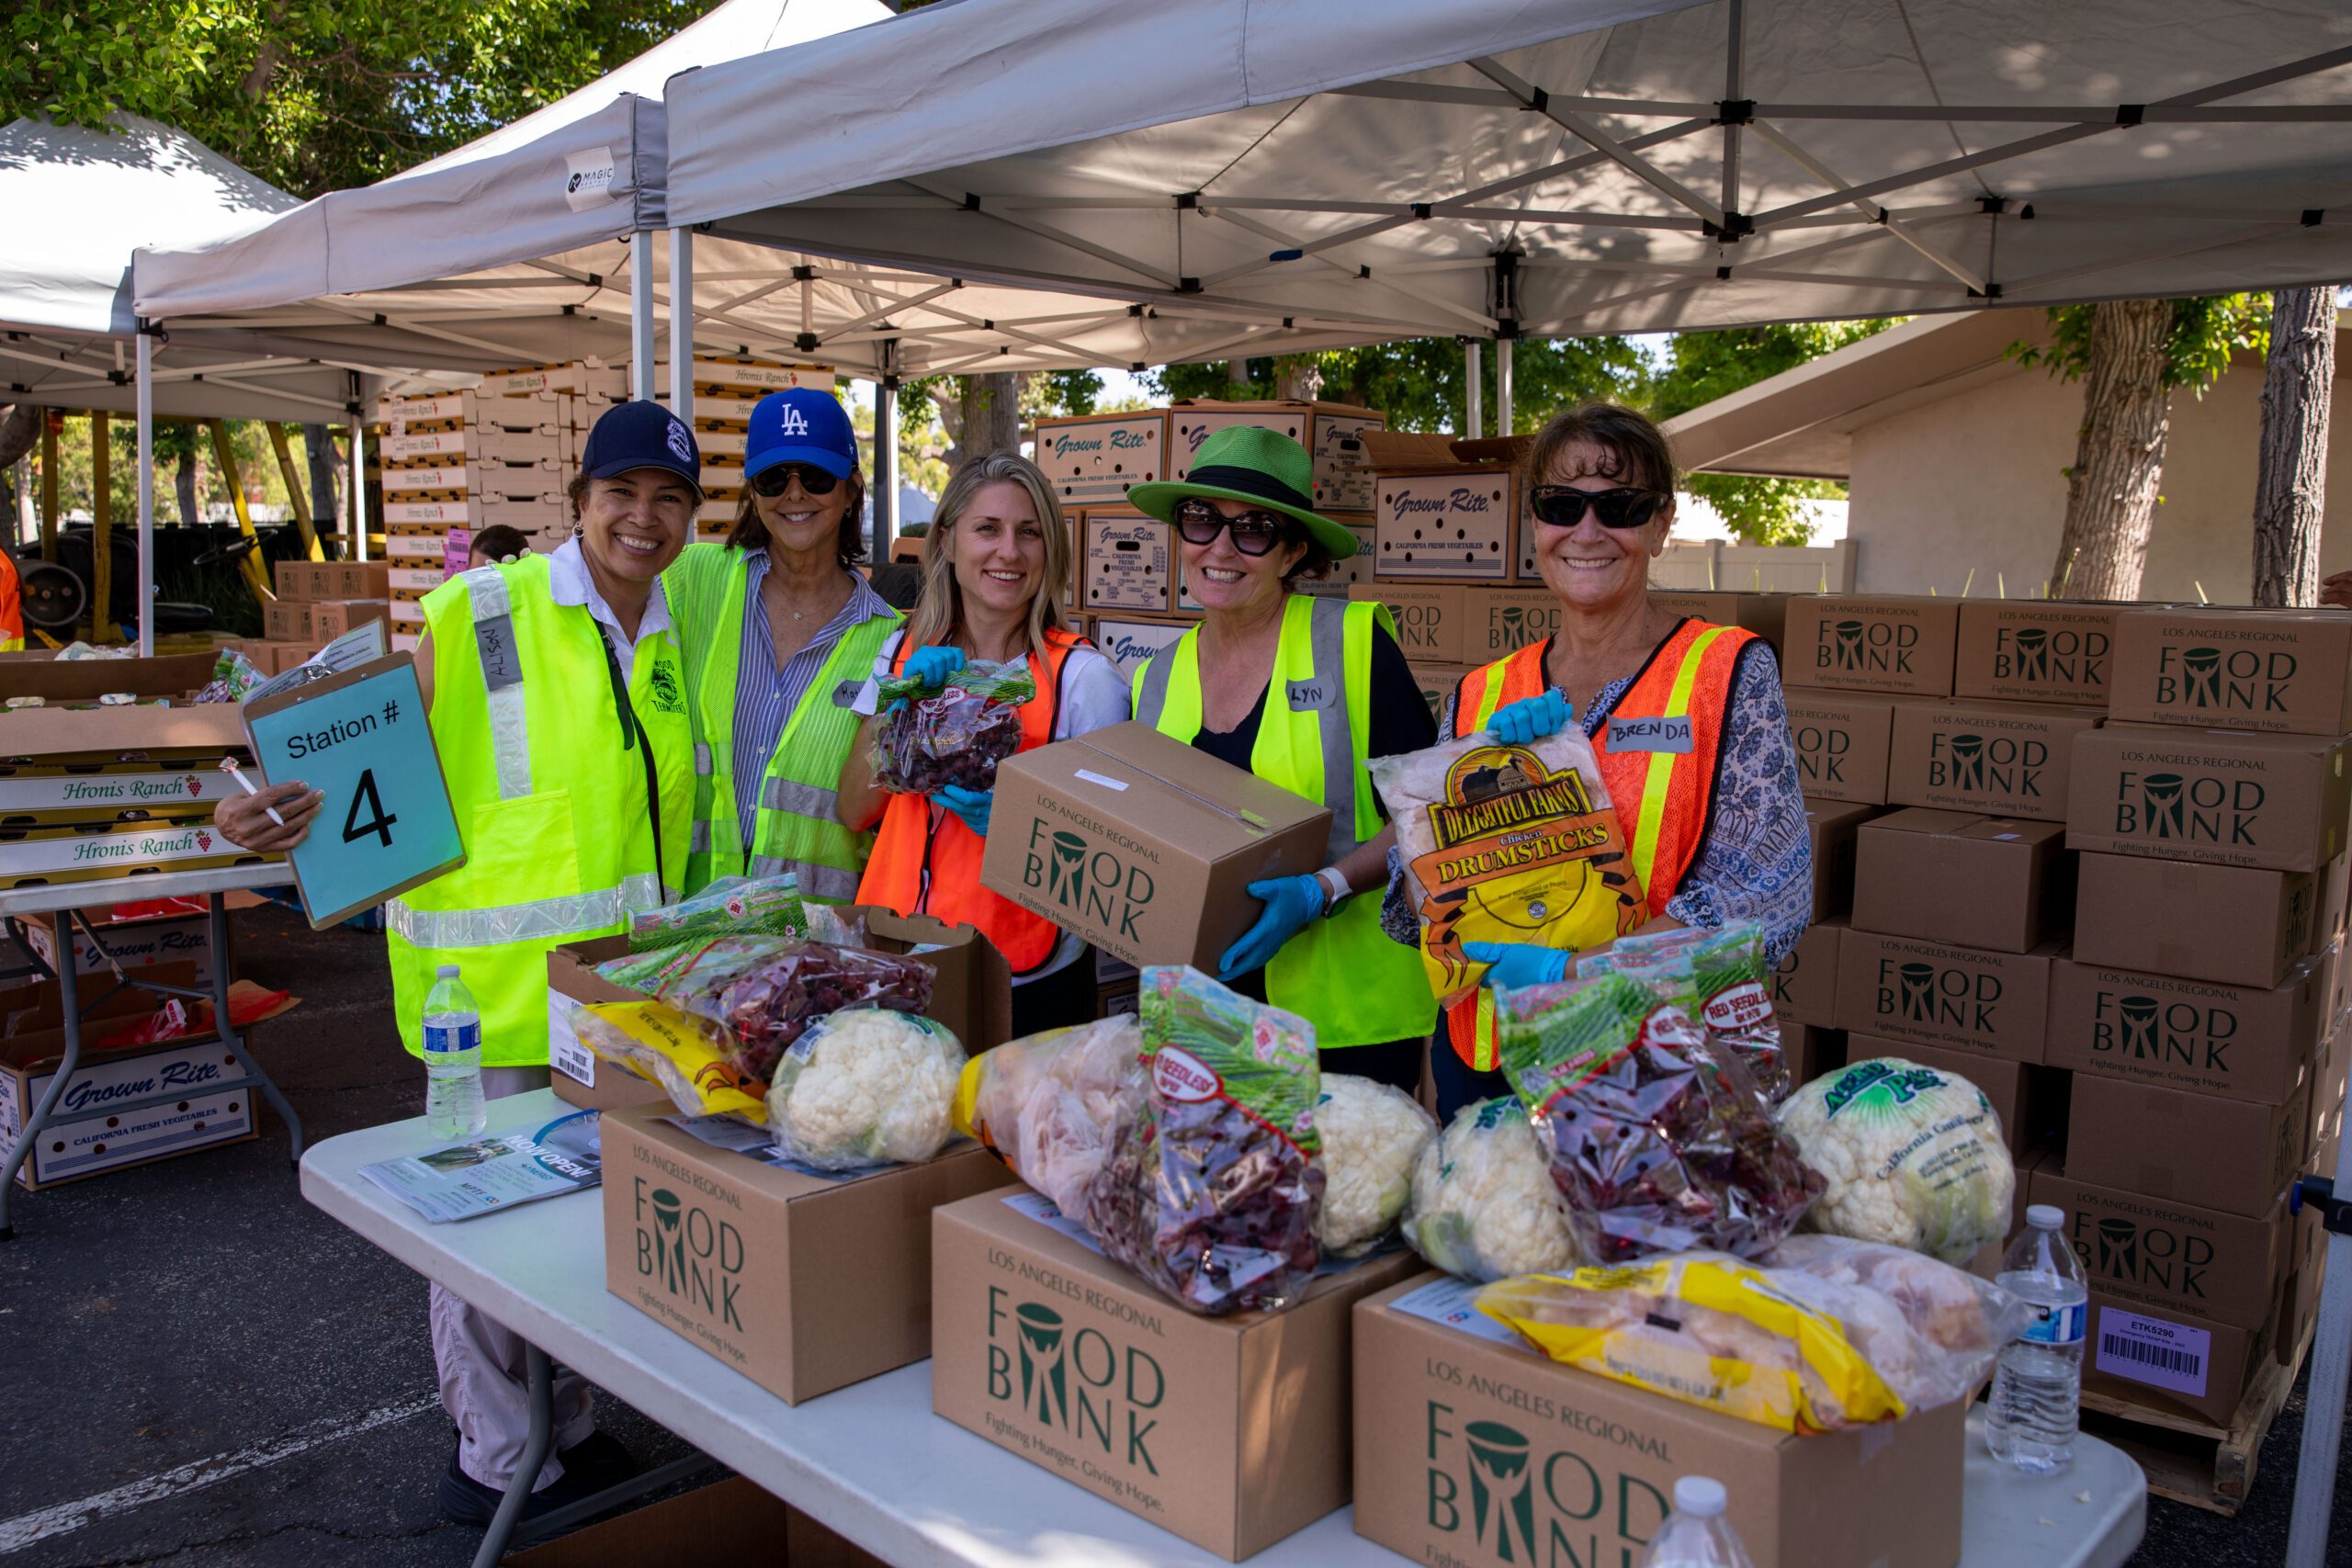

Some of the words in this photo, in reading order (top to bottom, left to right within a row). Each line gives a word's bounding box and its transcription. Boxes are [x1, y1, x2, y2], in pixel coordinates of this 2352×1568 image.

[735, 369, 763, 382] Hronis
[763, 371, 790, 384] Ranch
[781, 403, 808, 437] LA
[1055, 434, 1103, 460] Grown
[1393, 489, 1447, 522] Grown
[1100, 526, 1131, 545] Grown
[1446, 541, 1484, 549] VEGETABLES
[1820, 604, 1836, 613] LOS
[1838, 605, 1874, 615] ANGELES
[1876, 606, 1920, 616] REGIONAL
[1998, 611, 2017, 620] LOS
[2019, 612, 2060, 622] ANGELES
[2062, 614, 2110, 625] REGIONAL
[2163, 628, 2186, 637] LOS
[2188, 629, 2236, 640] ANGELES
[2237, 631, 2300, 644] REGIONAL
[1420, 676, 1450, 685] ANGELES
[1815, 673, 1840, 684] Fighting
[1841, 676, 1868, 685] Hunger.
[1870, 677, 1893, 687] Giving
[1894, 679, 1915, 688] Hope.
[1291, 686, 1323, 703] LYN
[286, 713, 378, 760] Station
[382, 699, 401, 726] #
[1806, 711, 1851, 722] REGIONAL
[1933, 716, 1951, 725] LOS
[1954, 717, 1996, 728] ANGELES
[1998, 720, 2050, 733] REGIONAL
[2153, 711, 2188, 724] Fighting
[2190, 713, 2224, 727] Hunger.
[2228, 716, 2259, 729] Giving
[2261, 719, 2291, 730] Hope.
[1611, 720, 1690, 742] BRENDA
[2120, 750, 2144, 761] LOS
[2146, 752, 2200, 765] ANGELES
[2203, 756, 2267, 772] REGIONAL
[62, 780, 124, 801] Hronis
[129, 776, 184, 796] Ranch
[342, 768, 398, 848] 4
[1442, 793, 1530, 844] DELIGHTFUL
[1526, 780, 1580, 817] FARMS
[1926, 793, 1957, 804] Fighting
[1958, 796, 1989, 807] Hunger.
[1990, 800, 2018, 811] Giving
[2018, 803, 2043, 813] Hope.
[1037, 795, 1057, 812] LOS
[1058, 806, 1104, 836] ANGELES
[1106, 829, 1161, 864] REGIONAL
[1499, 829, 1544, 846] Chicken
[74, 840, 135, 862] Hronis
[140, 832, 193, 855] Ranch
[1436, 823, 1610, 884] DRUMSTICKS
[2112, 840, 2150, 856] Fighting
[2152, 845, 2190, 859] Hunger.
[2193, 849, 2226, 863] Giving
[2228, 853, 2259, 866] Hope.
[1017, 892, 1050, 919] Fighting
[1051, 909, 1083, 935] Hunger.
[1085, 927, 1114, 953] Giving
[1114, 943, 1140, 964] Hope.
[1881, 940, 1900, 951] LOS
[1902, 942, 1948, 960] ANGELES
[1950, 951, 2005, 967] REGIONAL
[2098, 972, 2120, 984] LOS
[2122, 975, 2175, 992] ANGELES
[2177, 983, 2241, 1001] REGIONAL
[1708, 1002, 1730, 1020] RED
[1874, 1021, 1906, 1035] Fighting
[1908, 1027, 1940, 1041] Hunger.
[1942, 1033, 1971, 1047] Giving
[1972, 1039, 1998, 1050] Hope.
[2089, 1057, 2126, 1075] Fighting
[2128, 1064, 2165, 1080] Hunger.
[2167, 1071, 2200, 1088] Giving
[2202, 1077, 2233, 1092] Hope.
[63, 1074, 156, 1111] Grown
[74, 1125, 130, 1147] CALIFORNIA
[130, 1120, 161, 1135] FRESH
[162, 1107, 218, 1130] VEGETABLES
[507, 1134, 544, 1156] NOW
[540, 1151, 594, 1179] OPEN!
[1876, 1131, 1934, 1181] California
[633, 1143, 651, 1165] LOS
[650, 1158, 692, 1185] ANGELES
[692, 1171, 743, 1212] REGIONAL
[2076, 1193, 2098, 1205] LOS
[2101, 1198, 2152, 1218] ANGELES
[2154, 1209, 2216, 1231] REGIONAL
[989, 1247, 1015, 1272] LOS
[1018, 1260, 1082, 1302] ANGELES
[1085, 1288, 1167, 1337] REGIONAL
[2145, 1293, 2177, 1309] Giving
[2179, 1302, 2209, 1316] Hope.
[637, 1285, 666, 1316] Fighting
[666, 1303, 696, 1333] Hunger.
[696, 1324, 723, 1352] Giving
[723, 1338, 749, 1365] Hope.
[2131, 1321, 2175, 1338] ETK5290
[1427, 1358, 1463, 1386] LOS
[1467, 1377, 1555, 1420] ANGELES
[1561, 1401, 1673, 1464] REGIONAL
[985, 1411, 1031, 1449] Fighting
[1033, 1435, 1079, 1472] Hunger.
[1081, 1459, 1124, 1496] Giving
[1125, 1482, 1166, 1514] Hope.
